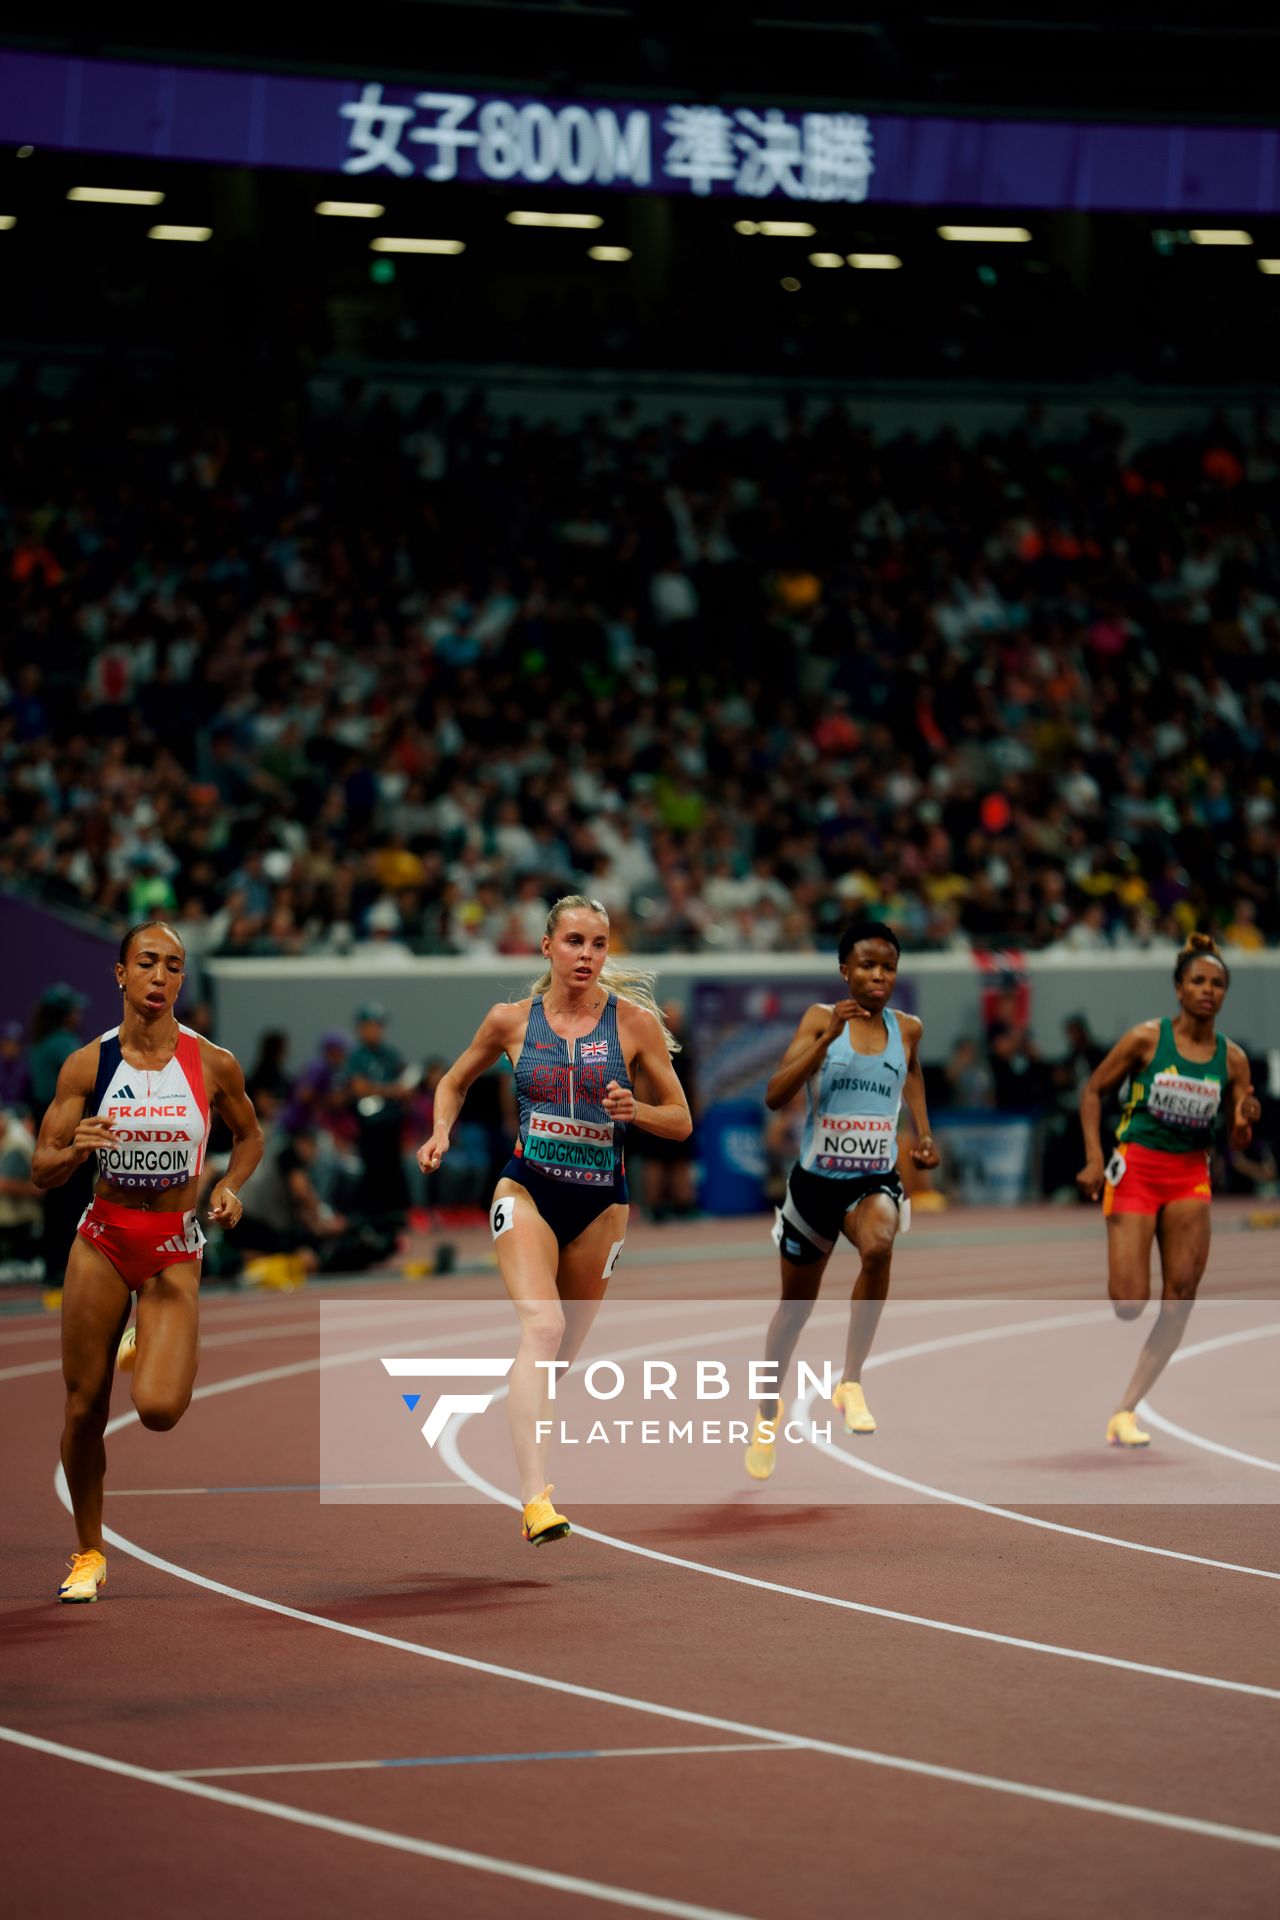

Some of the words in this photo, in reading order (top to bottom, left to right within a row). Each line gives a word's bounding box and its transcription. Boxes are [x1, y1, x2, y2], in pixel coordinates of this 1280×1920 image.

[663, 104, 874, 203] 準決勝
[533, 1065, 606, 1086] GREAT
[831, 1079, 892, 1099] BOTSWANA
[108, 1105, 187, 1118] FRANCE
[531, 1117, 613, 1141] HONDA
[821, 1118, 892, 1132] HONDA
[528, 1138, 612, 1168] HODGKINSON
[824, 1137, 888, 1155] NOWE
[100, 1149, 188, 1171] BOURGOIN
[494, 1204, 505, 1232] 6
